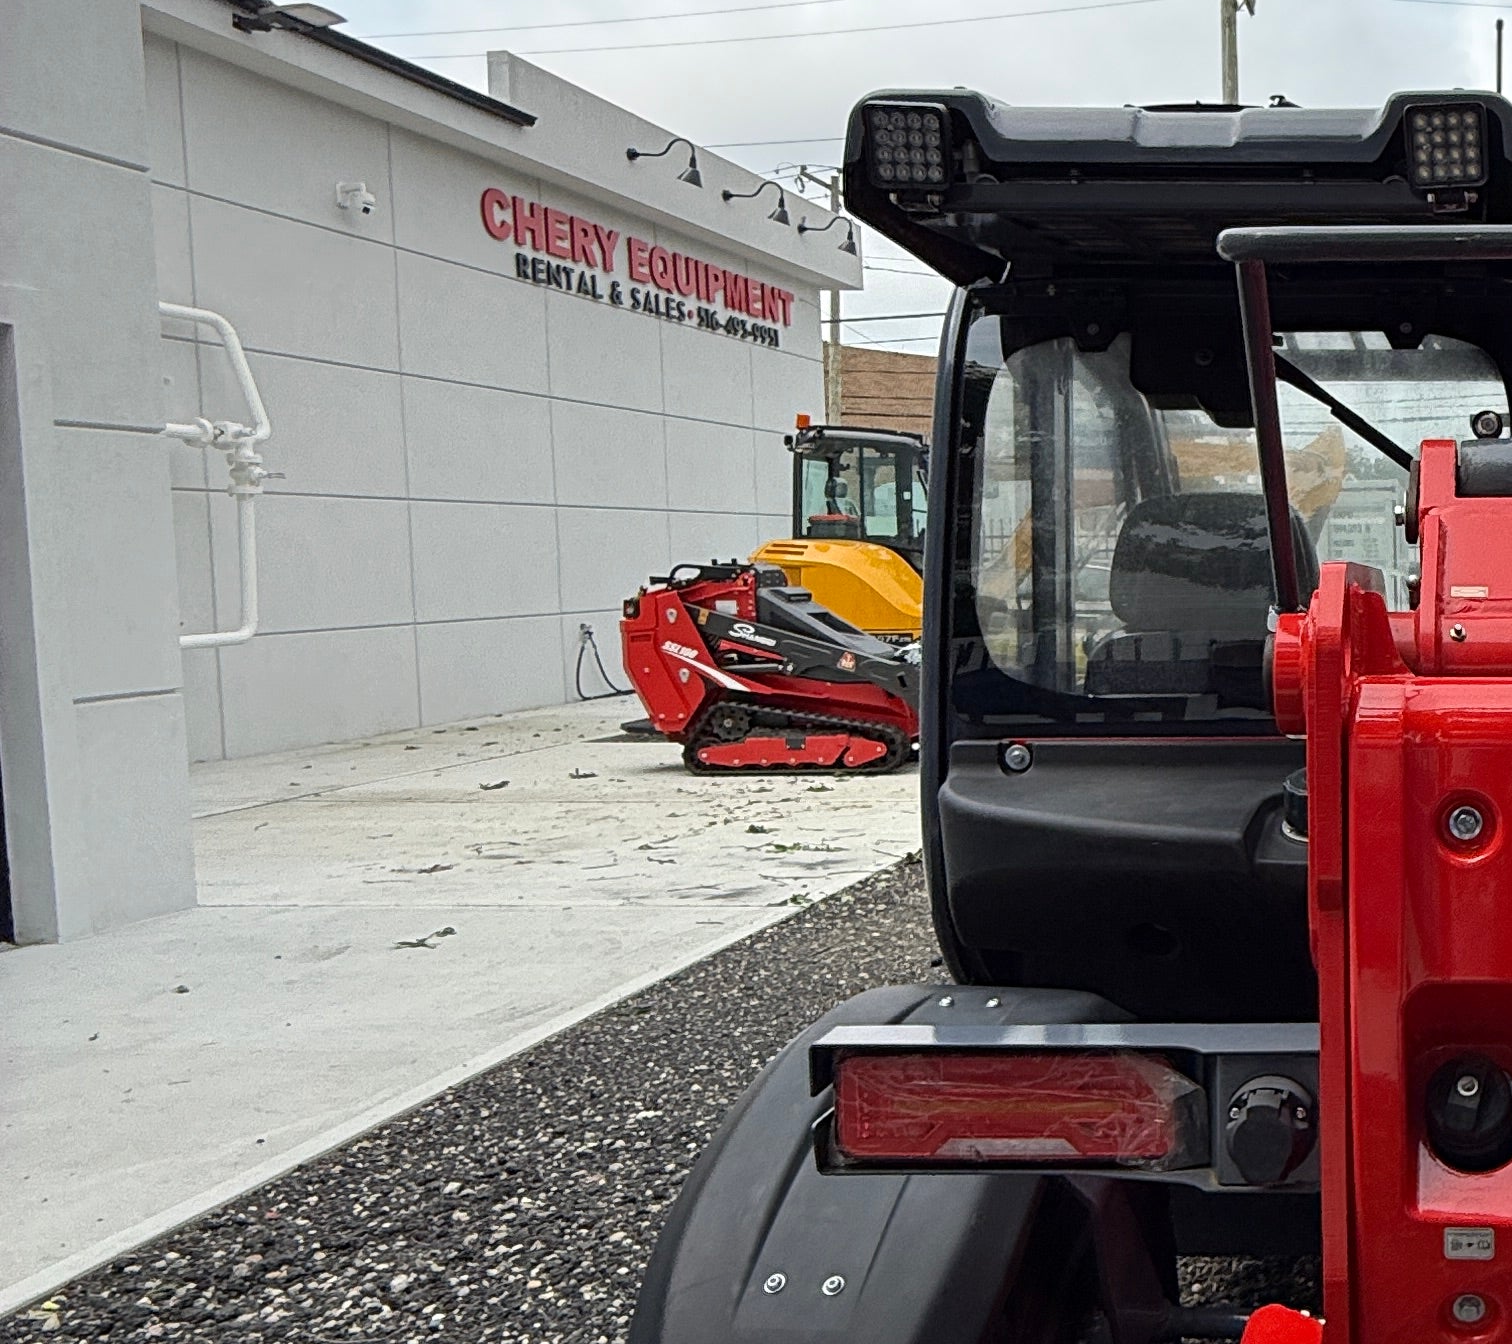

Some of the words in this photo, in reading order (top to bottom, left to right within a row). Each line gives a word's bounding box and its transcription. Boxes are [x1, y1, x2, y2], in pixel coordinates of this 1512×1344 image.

[481, 188, 620, 272] CHERY
[627, 236, 795, 327] EQUIPMENT
[515, 253, 604, 299] RENTAL
[610, 280, 624, 305] &
[631, 287, 686, 322] SALES
